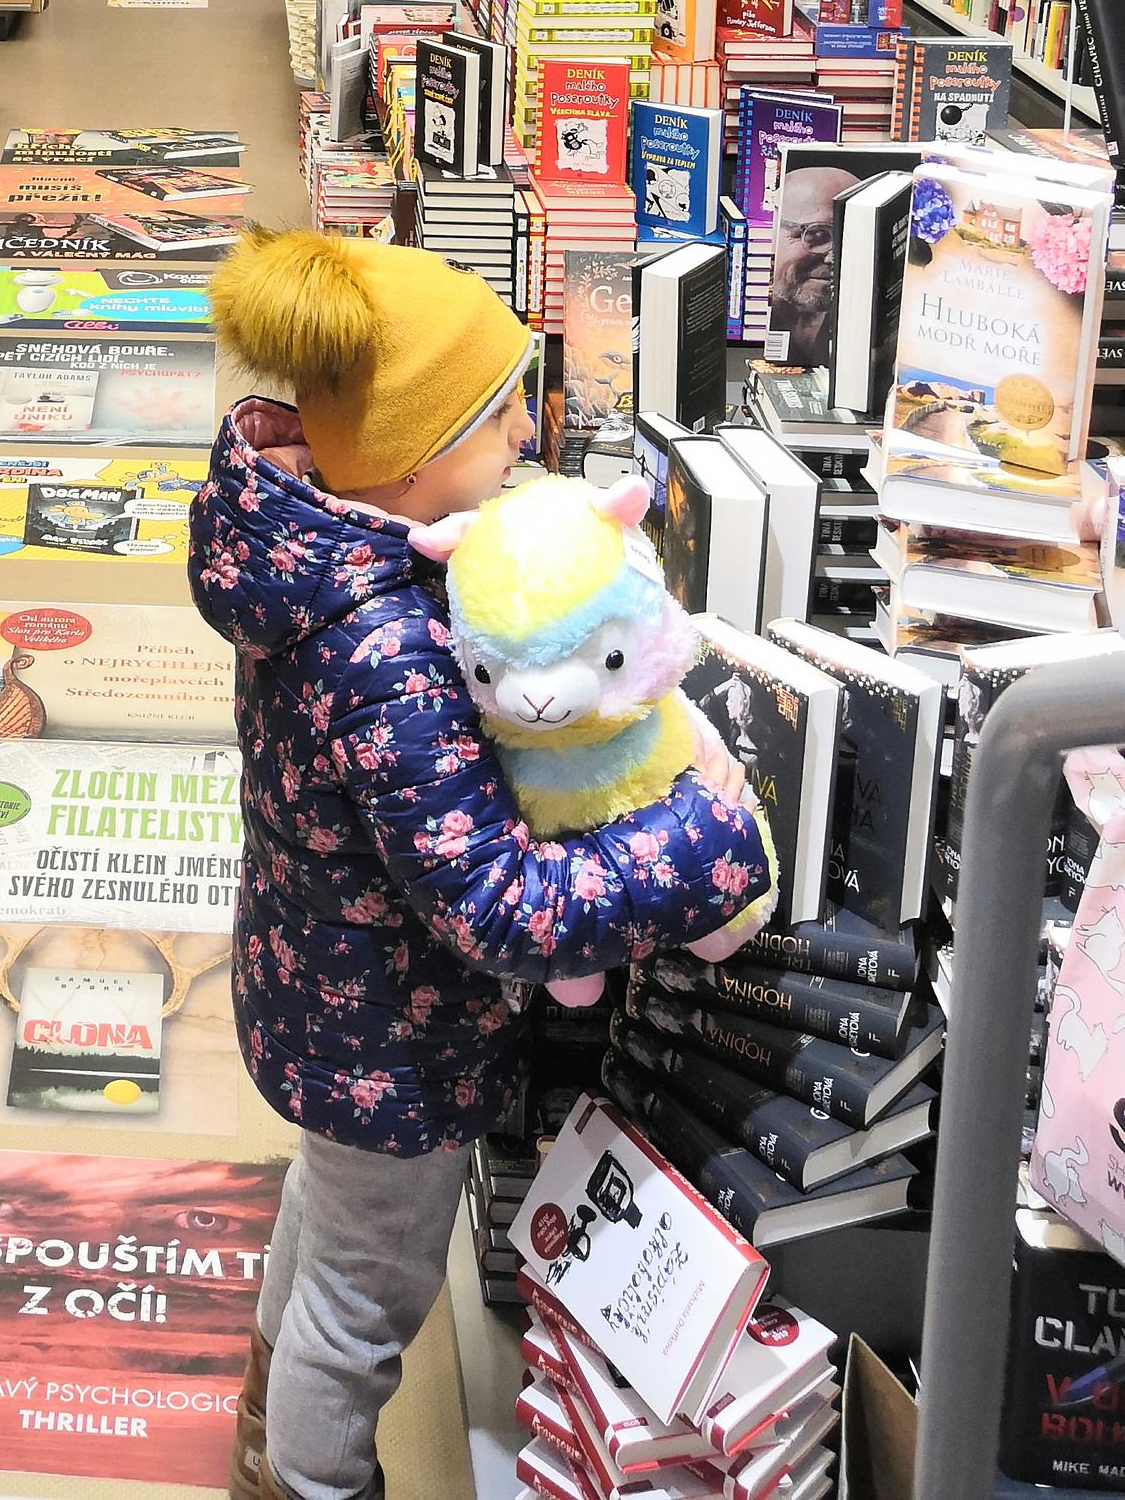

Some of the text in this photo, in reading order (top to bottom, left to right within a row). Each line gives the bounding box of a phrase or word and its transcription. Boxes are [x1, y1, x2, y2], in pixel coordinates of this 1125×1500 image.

[429, 52, 452, 68] DENÍK
[947, 50, 987, 62] DENÍK
[1086, 36, 1103, 87] CHLAPEC
[566, 67, 605, 80] DENÍK
[945, 63, 987, 74] malého
[655, 114, 688, 129] DENÍK
[775, 107, 812, 122] DENÍK
[15, 149, 112, 157] minulosti
[29, 249, 156, 259] VÁLEČNÝ MÁG
[957, 258, 1012, 281] MARIE
[943, 272, 1026, 300] LAMBALLE
[90, 303, 139, 312] knihy
[920, 291, 1041, 345] HLUBOKÁ
[16, 342, 174, 357] SNĚHOVÁ BOUŘE.
[983, 340, 1042, 367] MOŘE
[28, 352, 84, 363] CIZÍCH
[88, 353, 124, 363] LIDÍ.
[14, 372, 53, 380] TAYLOR
[118, 369, 202, 378] PSYCHOPAT?
[22, 404, 68, 413] NENÍ
[14, 412, 73, 421] ÚNIKU
[19, 614, 76, 624] Od autora
[24, 622, 68, 630] románu
[7, 627, 55, 637] Slon pro
[136, 643, 196, 656] Příběh
[103, 674, 225, 687] mořeplavcích
[64, 686, 201, 702] Středozemního
[52, 766, 235, 805] ZLOČIN MEZ
[46, 806, 243, 843] FILATELISTY
[36, 847, 100, 871] OČISTÍ
[106, 853, 167, 875] KLEIN
[8, 872, 201, 903] SVÉHO ZESNULÉHO
[54, 976, 133, 985] SAMUEL
[723, 974, 793, 1012] HODINA
[23, 1019, 153, 1050] CLONA
[19, 1283, 167, 1324] Z OČÍ!
[46, 1384, 240, 1414] PSYCHOLOGIC
[19, 1409, 148, 1437] THRILLER
[1052, 1459, 1089, 1474] MIKE
